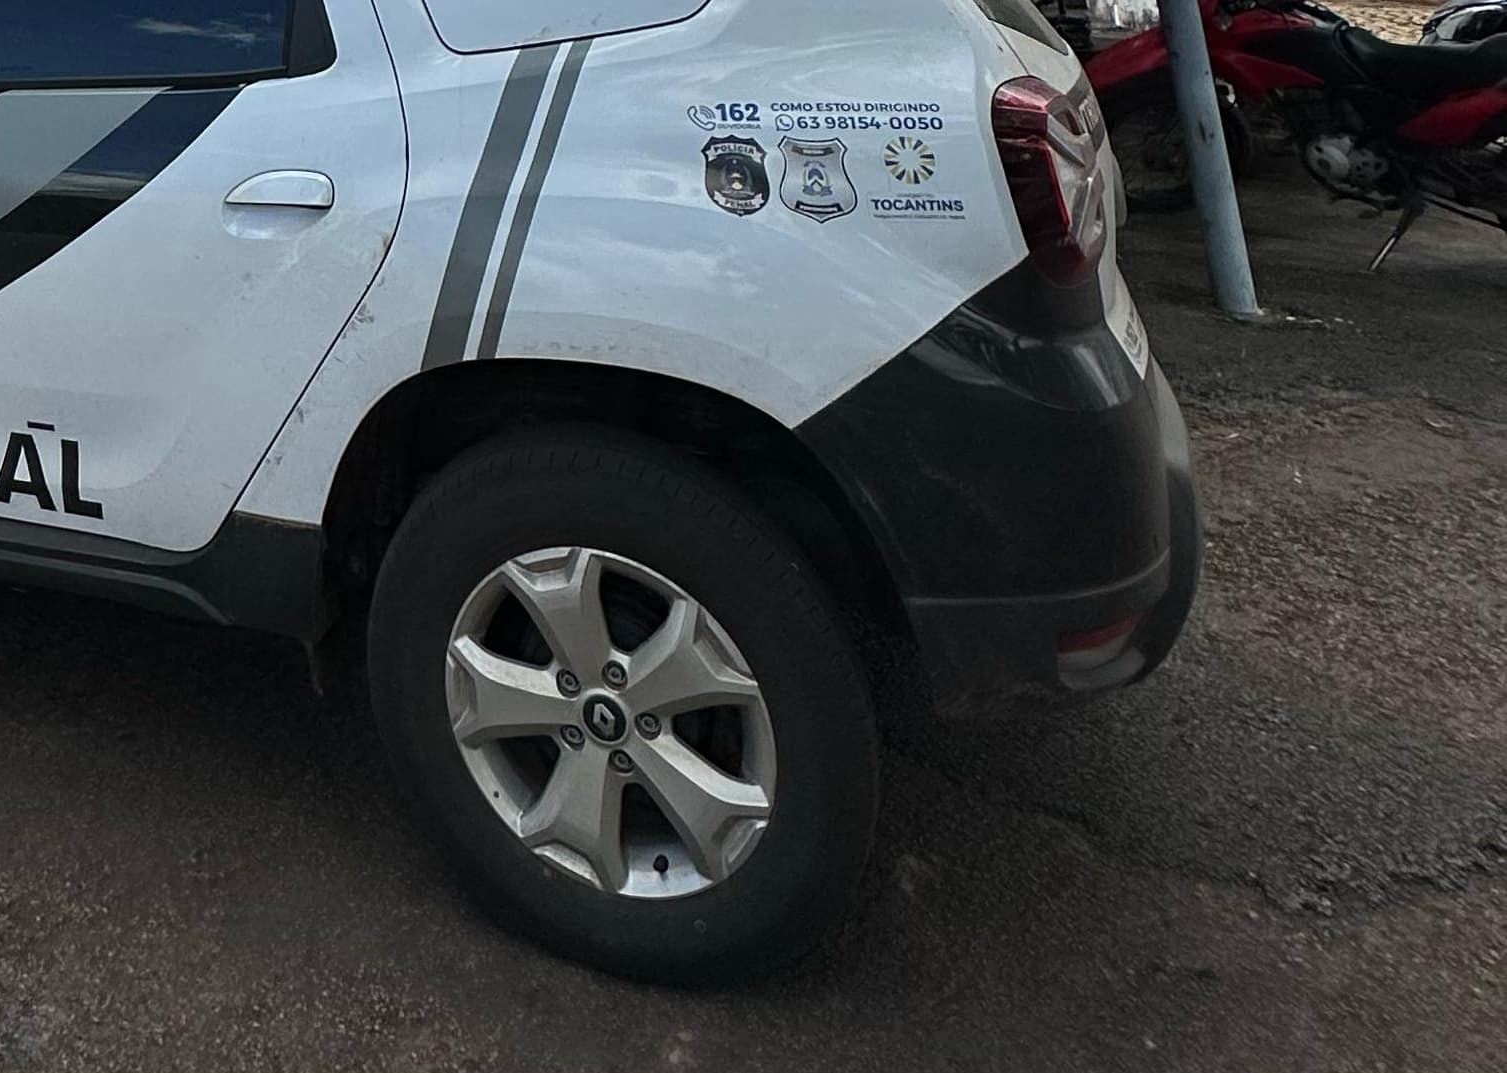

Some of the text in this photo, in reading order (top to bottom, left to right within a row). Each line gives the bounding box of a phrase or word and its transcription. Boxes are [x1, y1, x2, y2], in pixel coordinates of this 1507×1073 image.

[715, 103, 760, 121] 162
[770, 102, 940, 113] COMO ESTOU DIRIGINDO
[797, 116, 943, 130] 63 98154-0050
[870, 199, 964, 212] TOCANTINS
